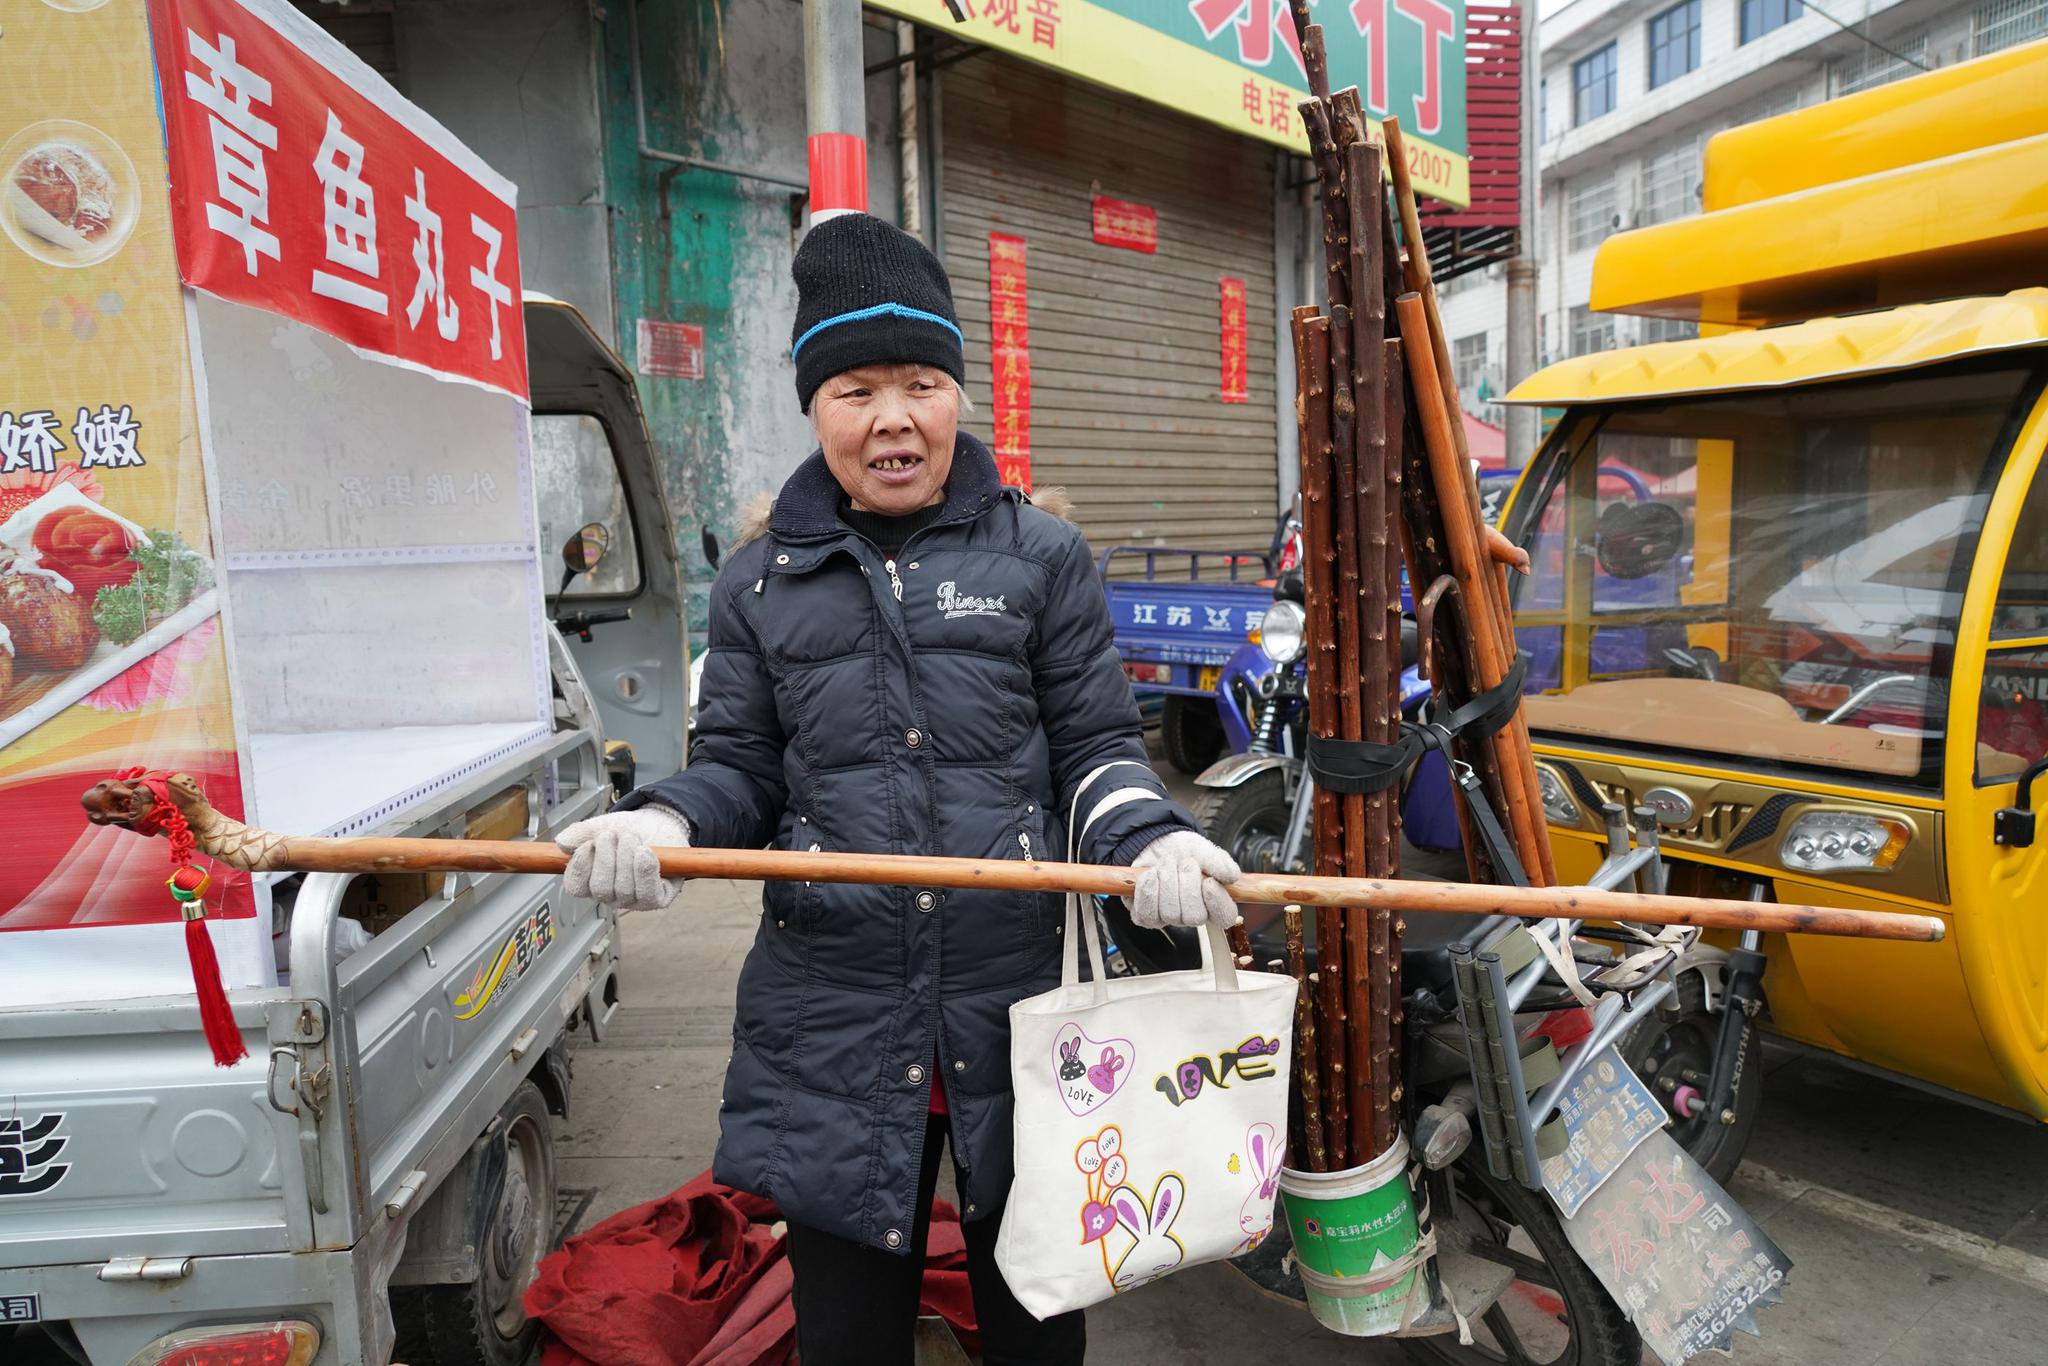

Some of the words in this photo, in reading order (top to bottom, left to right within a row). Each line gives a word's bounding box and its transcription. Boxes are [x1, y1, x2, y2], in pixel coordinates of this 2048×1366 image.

[939, 0, 1062, 49] 观音
[184, 27, 513, 361] 章鱼丸子
[0, 404, 145, 474] 娇嫩
[1133, 604, 1192, 626] 江苏
[1155, 1044, 1278, 1107] LOVE
[1067, 1086, 1094, 1107] LOVE
[1101, 1136, 1116, 1151] LOVE
[1084, 1157, 1099, 1168] LOVE
[1108, 1161, 1121, 1178] LOVE
[1158, 1200, 1170, 1221] LOVE
